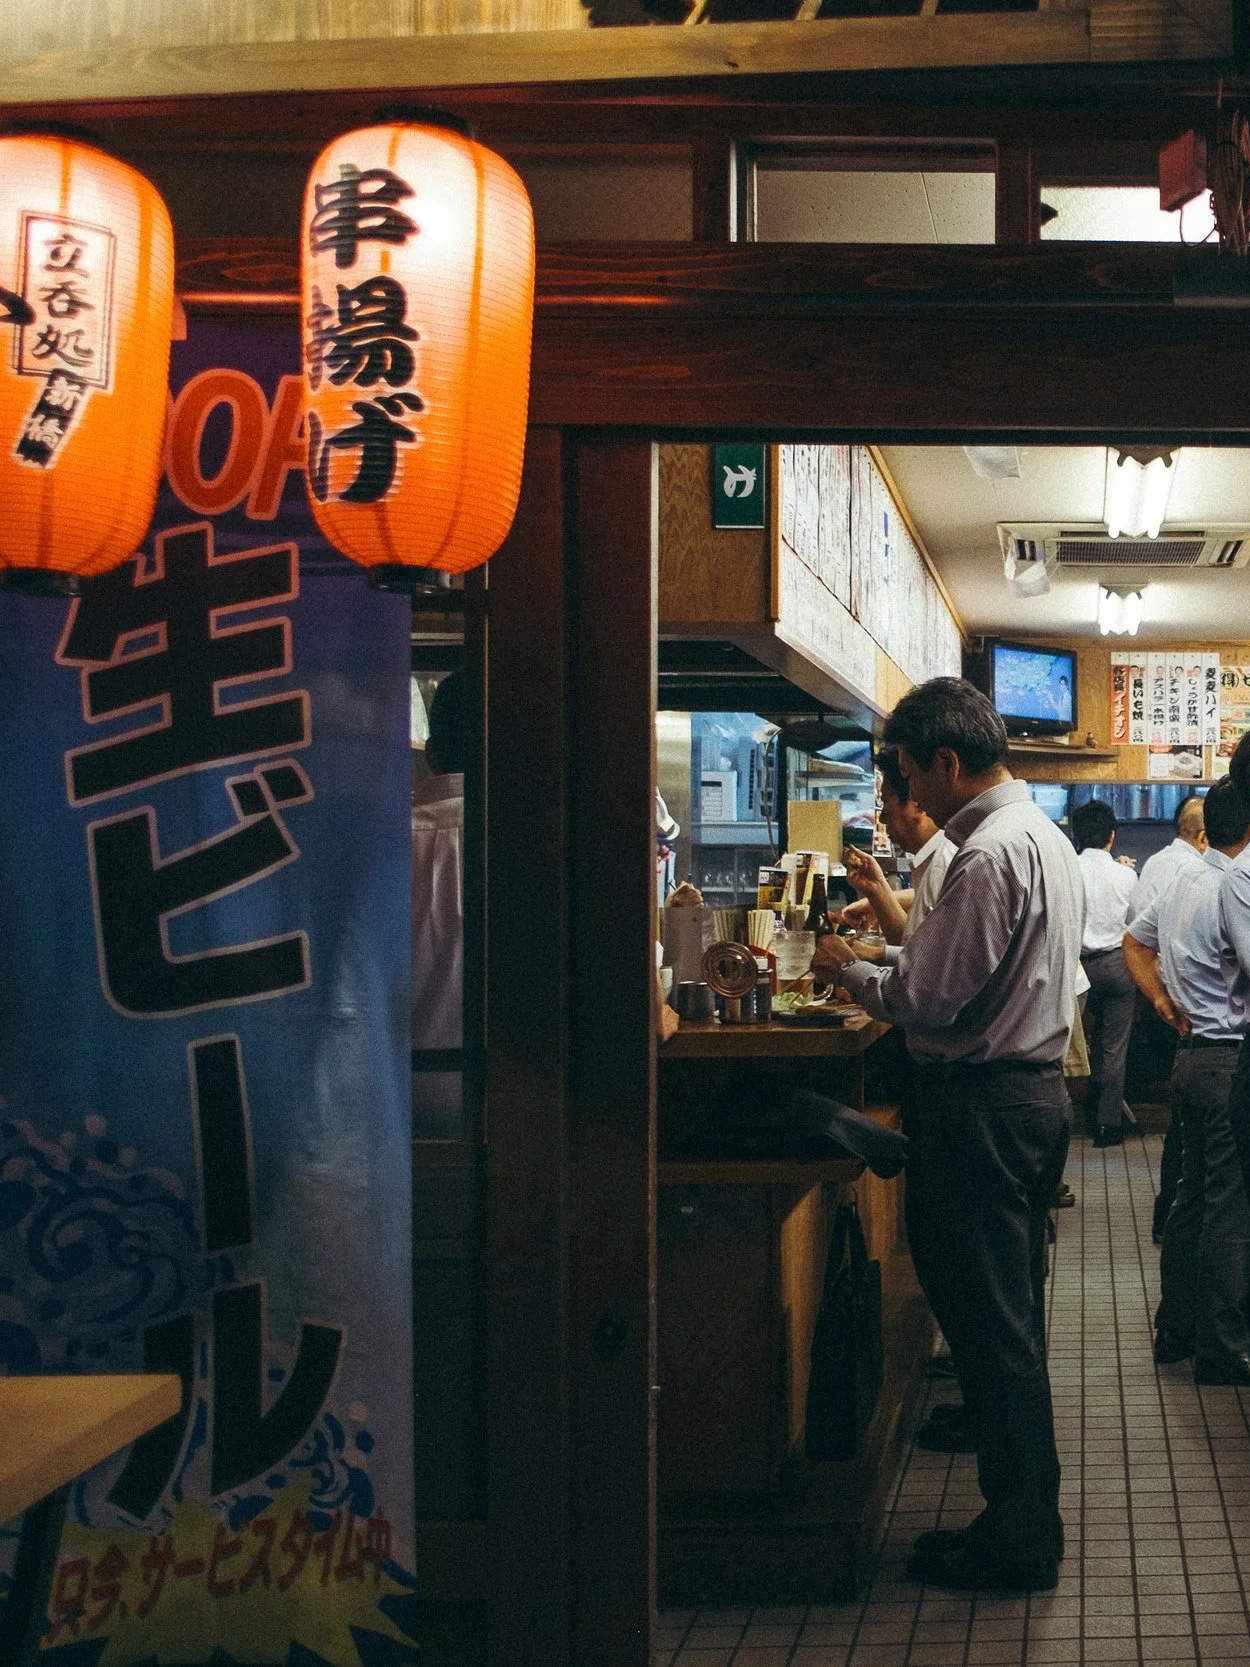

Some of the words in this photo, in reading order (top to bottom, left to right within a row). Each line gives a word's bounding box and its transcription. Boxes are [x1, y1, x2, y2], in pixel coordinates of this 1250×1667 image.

[33, 232, 97, 367] 立呑処
[307, 163, 427, 504] 串揚げ
[55, 521, 348, 1522] 生ビール
